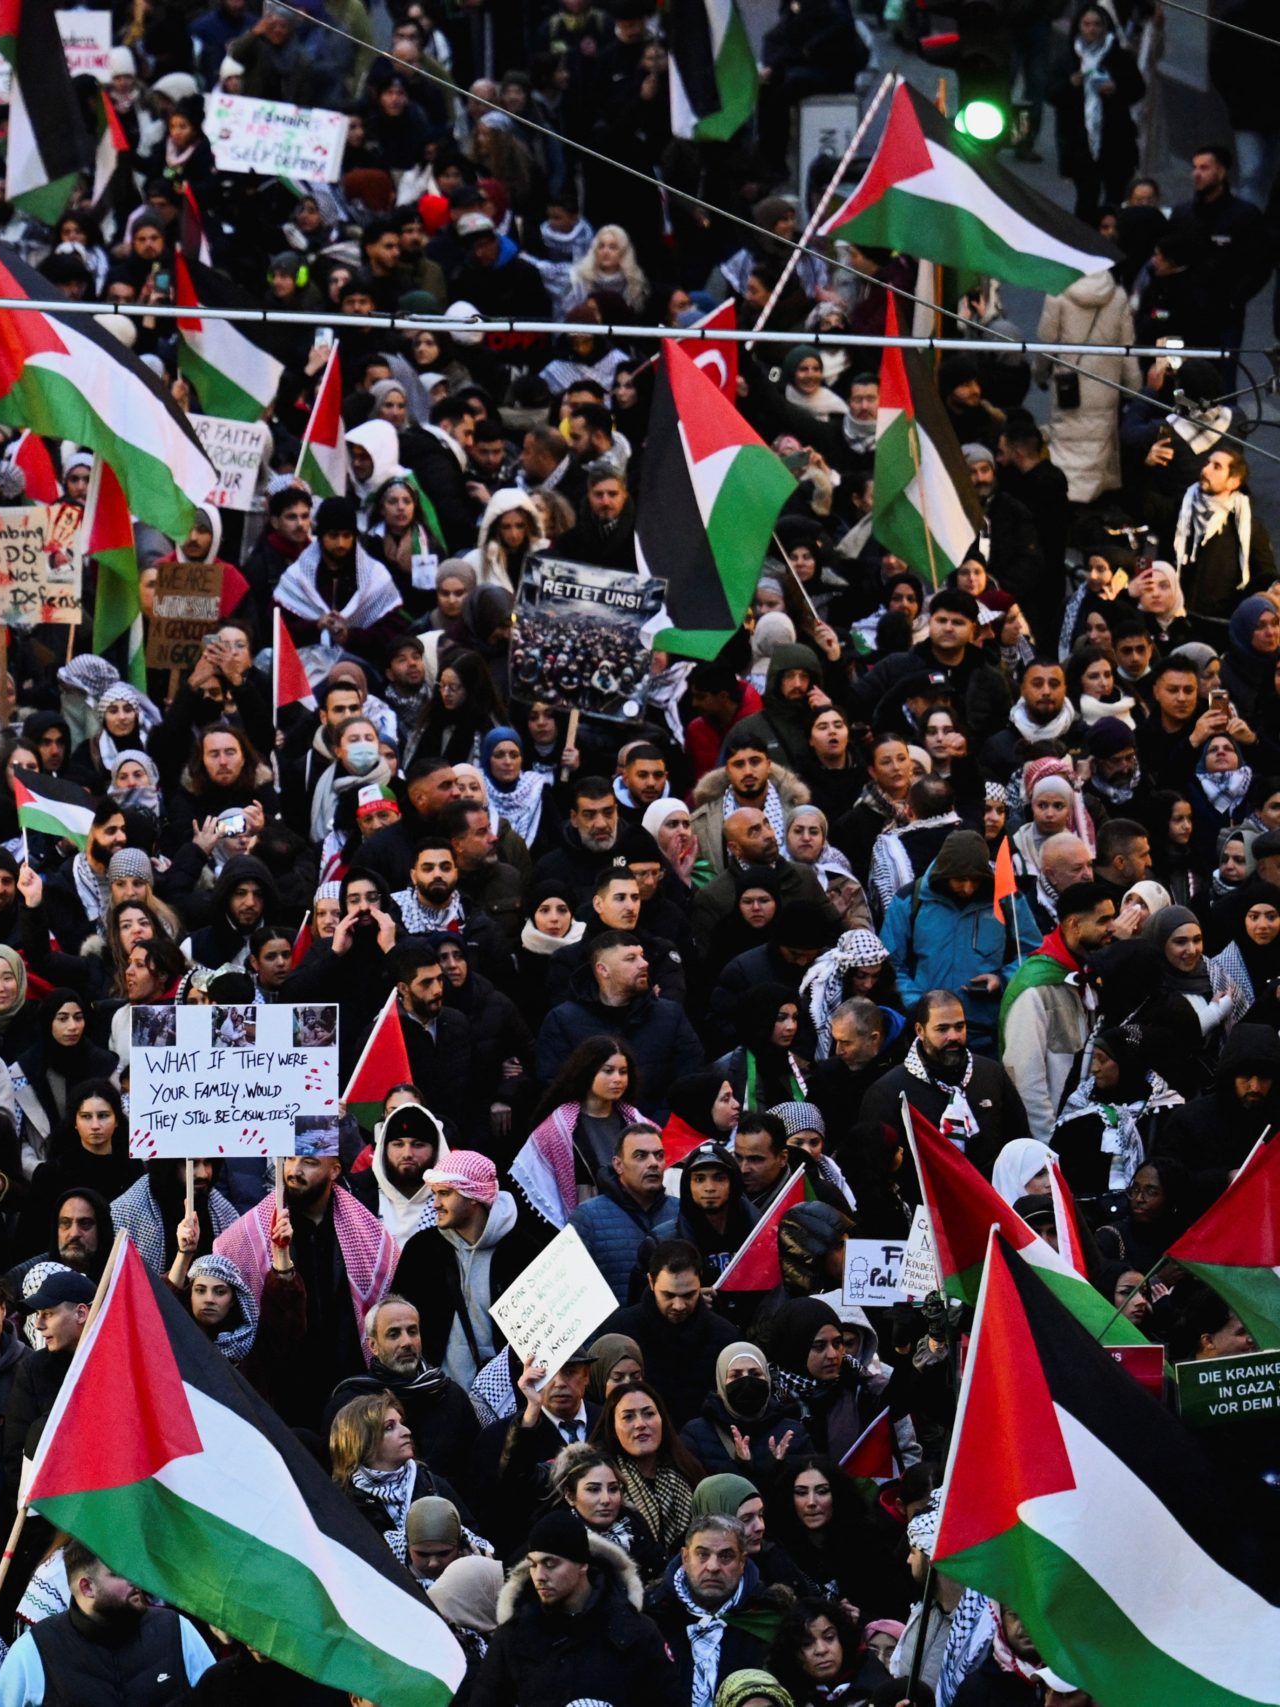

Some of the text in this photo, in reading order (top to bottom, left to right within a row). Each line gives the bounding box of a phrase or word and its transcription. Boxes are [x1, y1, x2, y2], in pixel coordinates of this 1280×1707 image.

[214, 424, 261, 447] FAITH
[8, 567, 39, 583] Not
[542, 579, 642, 609] RETTET UNS!
[145, 1049, 308, 1075] WHAT IF THEY WERE
[150, 1083, 190, 1105] YOUR
[245, 1082, 282, 1099] WOULD
[140, 1109, 178, 1132] THEY
[182, 1109, 211, 1126] STILL
[213, 1109, 231, 1124] BE
[1198, 1370, 1223, 1385] DIE
[1218, 1386, 1233, 1399] IN
[1236, 1380, 1275, 1396] GAZA
[1209, 1401, 1239, 1416] VOR
[1242, 1397, 1273, 1412] DEM
